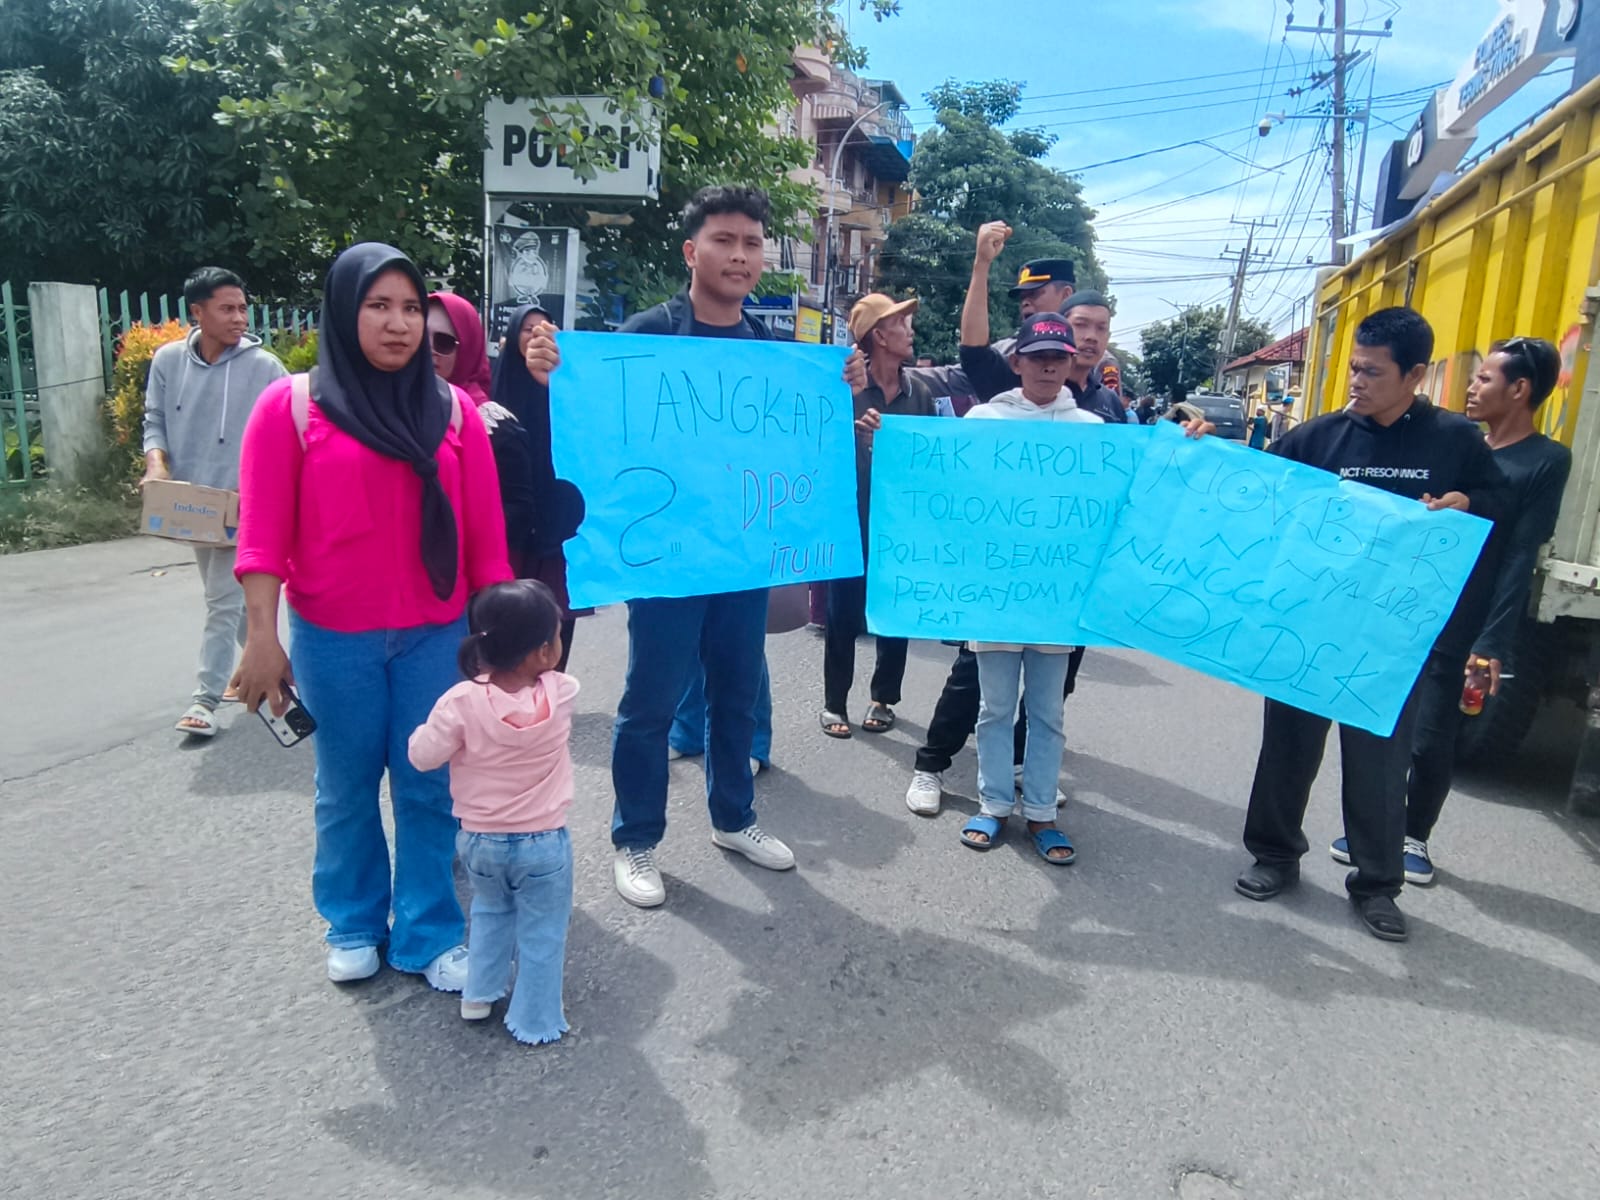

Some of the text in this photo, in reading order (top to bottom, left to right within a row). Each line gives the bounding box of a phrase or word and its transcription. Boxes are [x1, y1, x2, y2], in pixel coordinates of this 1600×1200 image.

[503, 124, 631, 168] POLI
[602, 353, 834, 455] TANGKAP
[910, 432, 1137, 477] PAK KAPOLRI
[902, 490, 1037, 529] TOLONG
[877, 533, 966, 569] POLISI
[985, 541, 1092, 569] BENAR
[894, 575, 1060, 611] PENGAYOM
[917, 607, 965, 625] KAT
